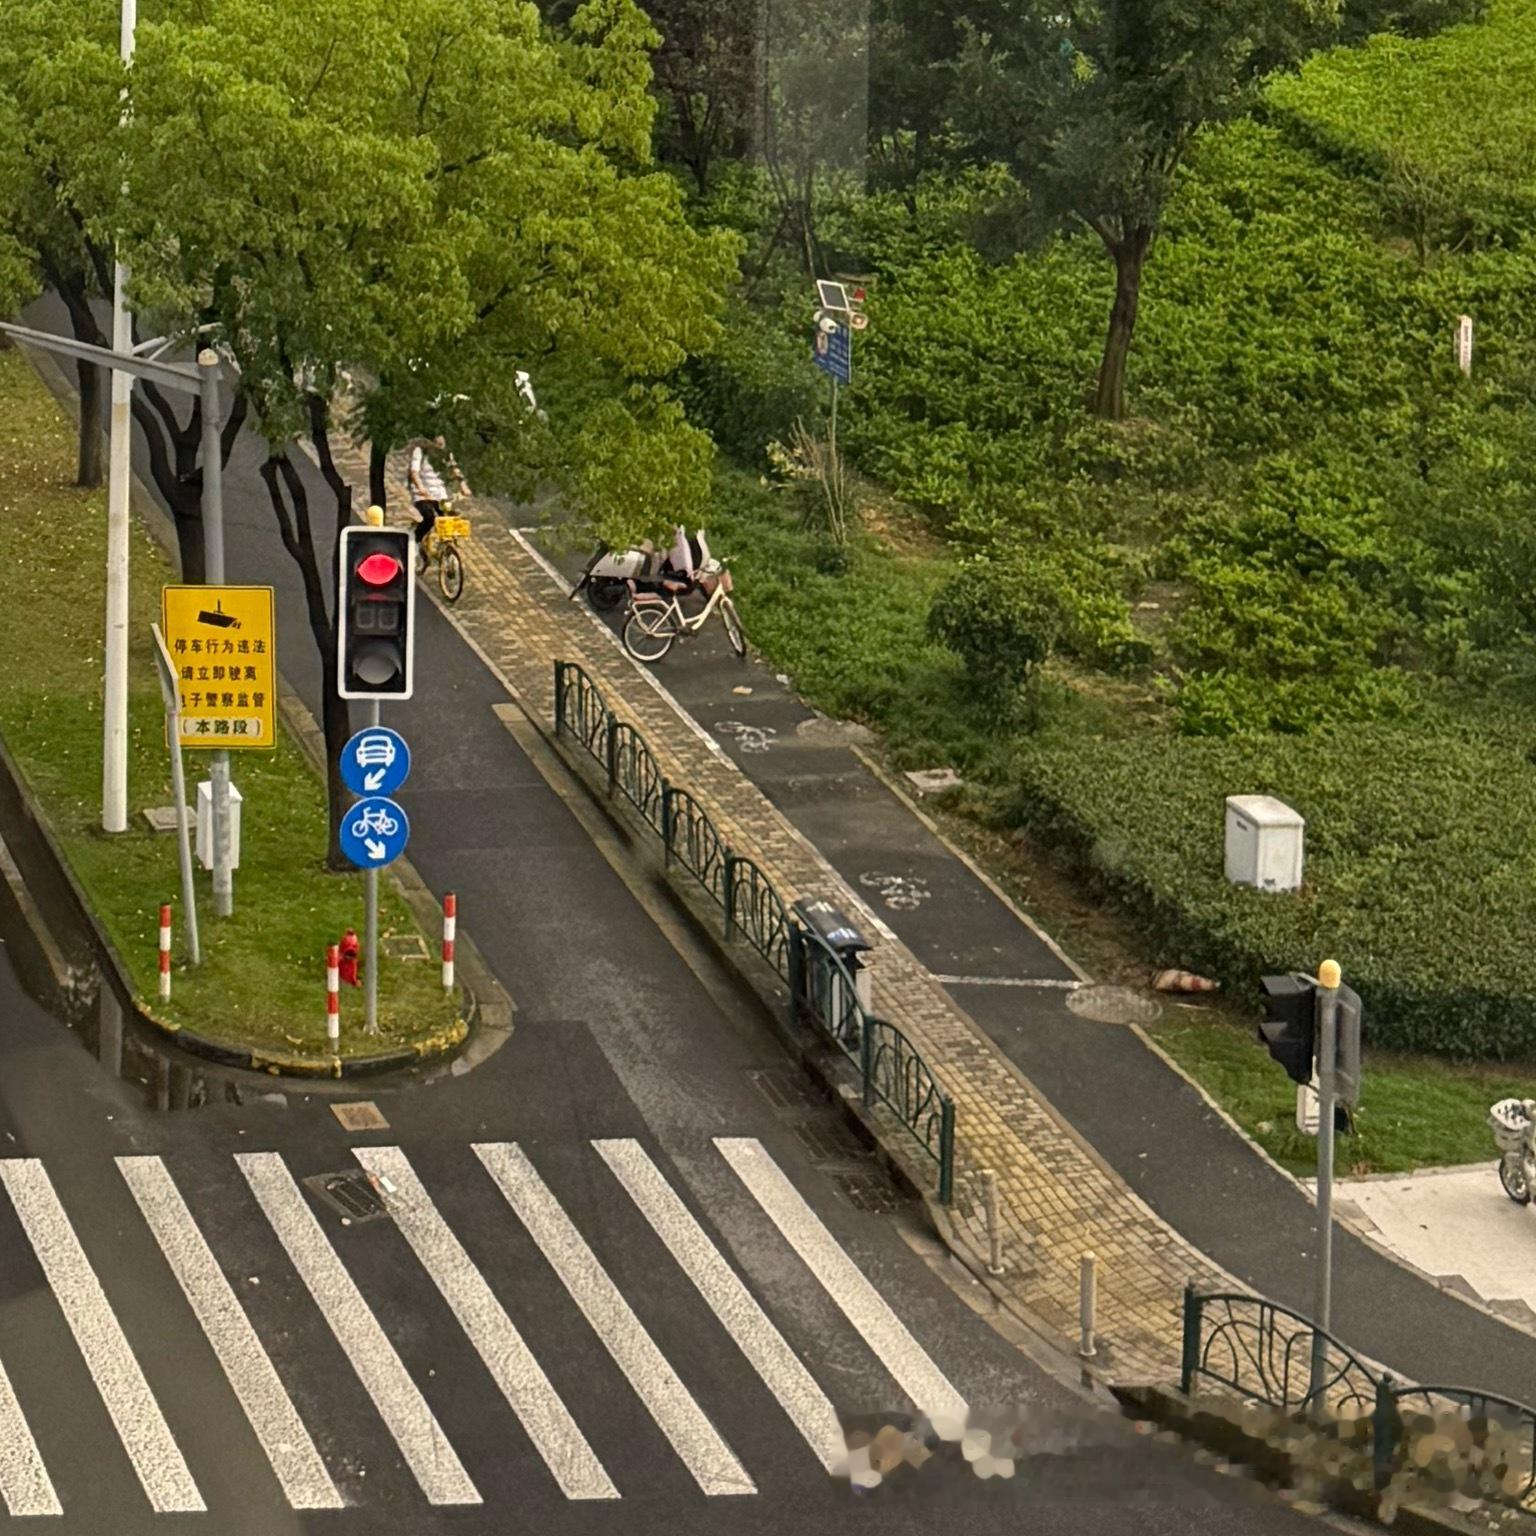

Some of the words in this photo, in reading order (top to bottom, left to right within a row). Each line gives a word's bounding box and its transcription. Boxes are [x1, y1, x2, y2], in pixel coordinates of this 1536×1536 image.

[175, 638, 266, 654] 停车行为违法
